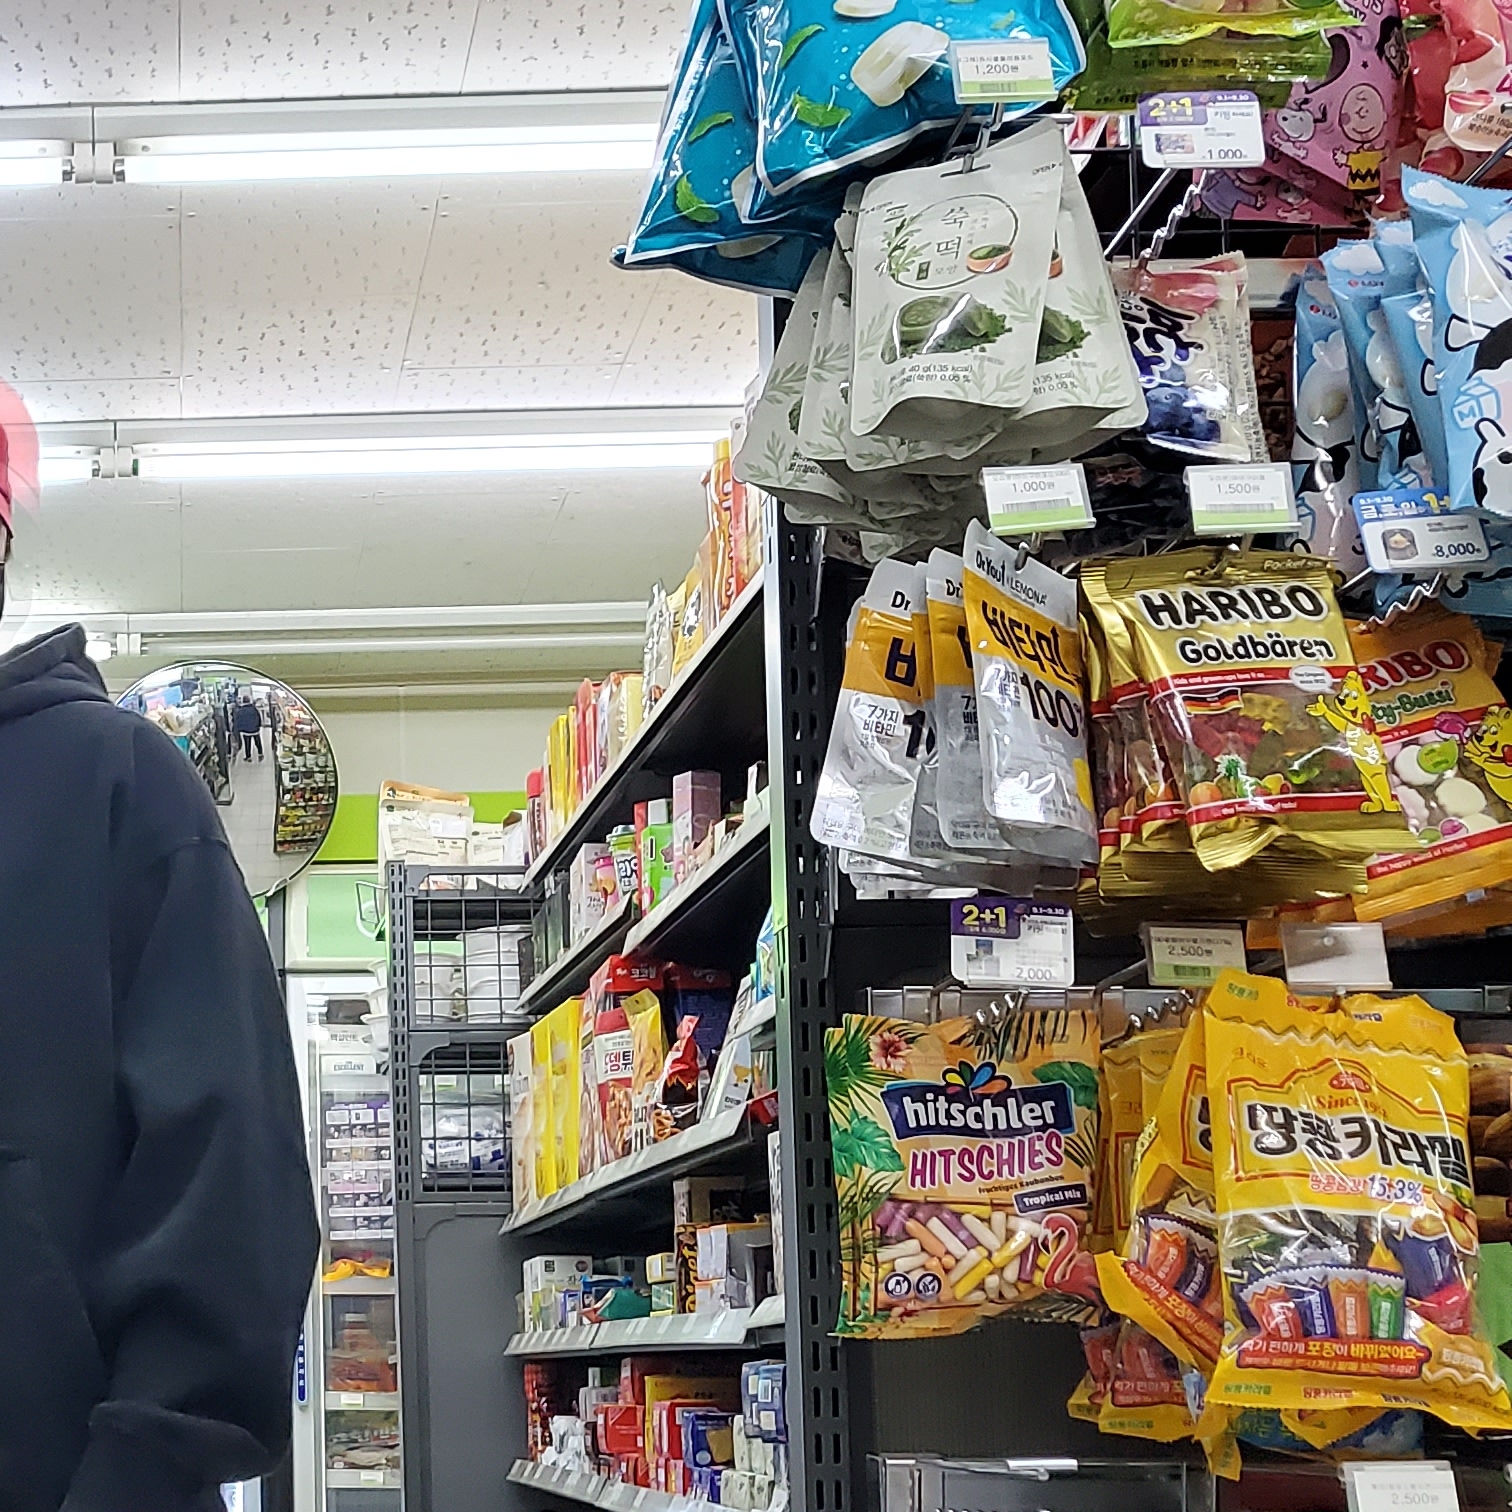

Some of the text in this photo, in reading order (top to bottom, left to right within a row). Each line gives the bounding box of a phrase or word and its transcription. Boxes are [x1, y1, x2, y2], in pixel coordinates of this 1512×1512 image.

[1148, 97, 1194, 117] 2+1
[1011, 480, 1055, 493] 1,000원
[1217, 482, 1260, 494] 1,500원
[1139, 584, 1324, 628] HARIBO
[1179, 633, 1335, 664] Goldbären
[1361, 639, 1468, 692] RIBO
[962, 905, 1006, 926] 2+1
[902, 1093, 1056, 1130] hitschler
[1246, 1103, 1472, 1188] 땅콩카라멜
[909, 1129, 1064, 1189] HITSCHIES
[1023, 1189, 1083, 1207] Tropical Mix
[1307, 1341, 1348, 1358] 포장이
